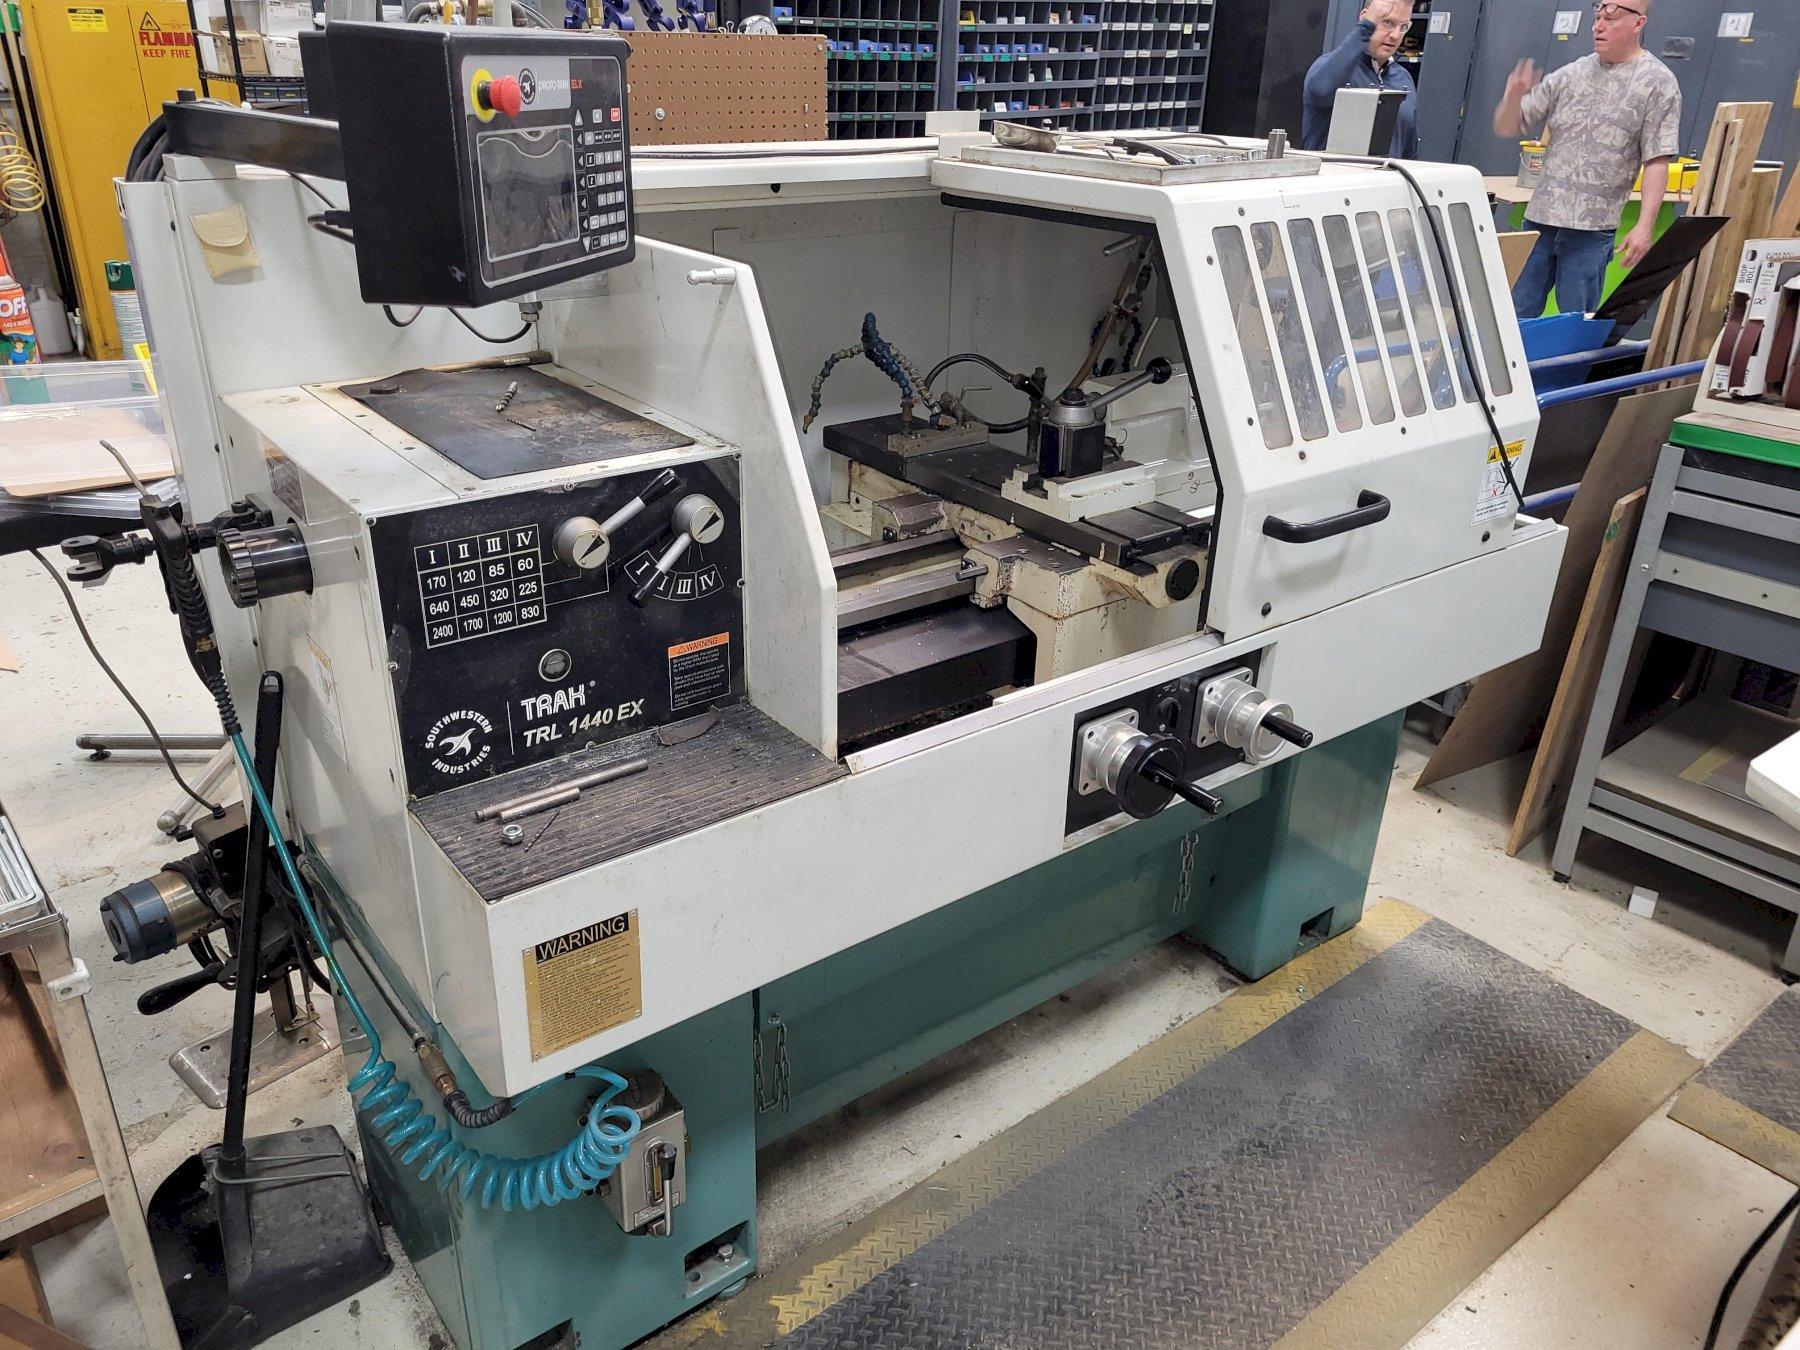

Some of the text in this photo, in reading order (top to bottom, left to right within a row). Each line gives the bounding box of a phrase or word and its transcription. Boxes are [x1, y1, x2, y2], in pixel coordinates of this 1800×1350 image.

[143, 49, 191, 58] KEEP FIRE
[1739, 264, 1748, 284] SHOP
[429, 531, 532, 564] I II III IV
[427, 557, 534, 590] 170 120 85 60
[676, 579, 692, 594] III
[699, 571, 716, 591] IV
[429, 581, 538, 615] 640 450 320 225
[432, 605, 540, 640] 2400 1700 1200 830
[687, 637, 718, 651] WARNING
[520, 683, 586, 721] TRAK
[425, 710, 493, 749] SOUTHWESTERN
[523, 698, 645, 748] TRL 1440 EX
[431, 745, 491, 775] INDUSTRIES
[539, 915, 625, 959] WARNING
